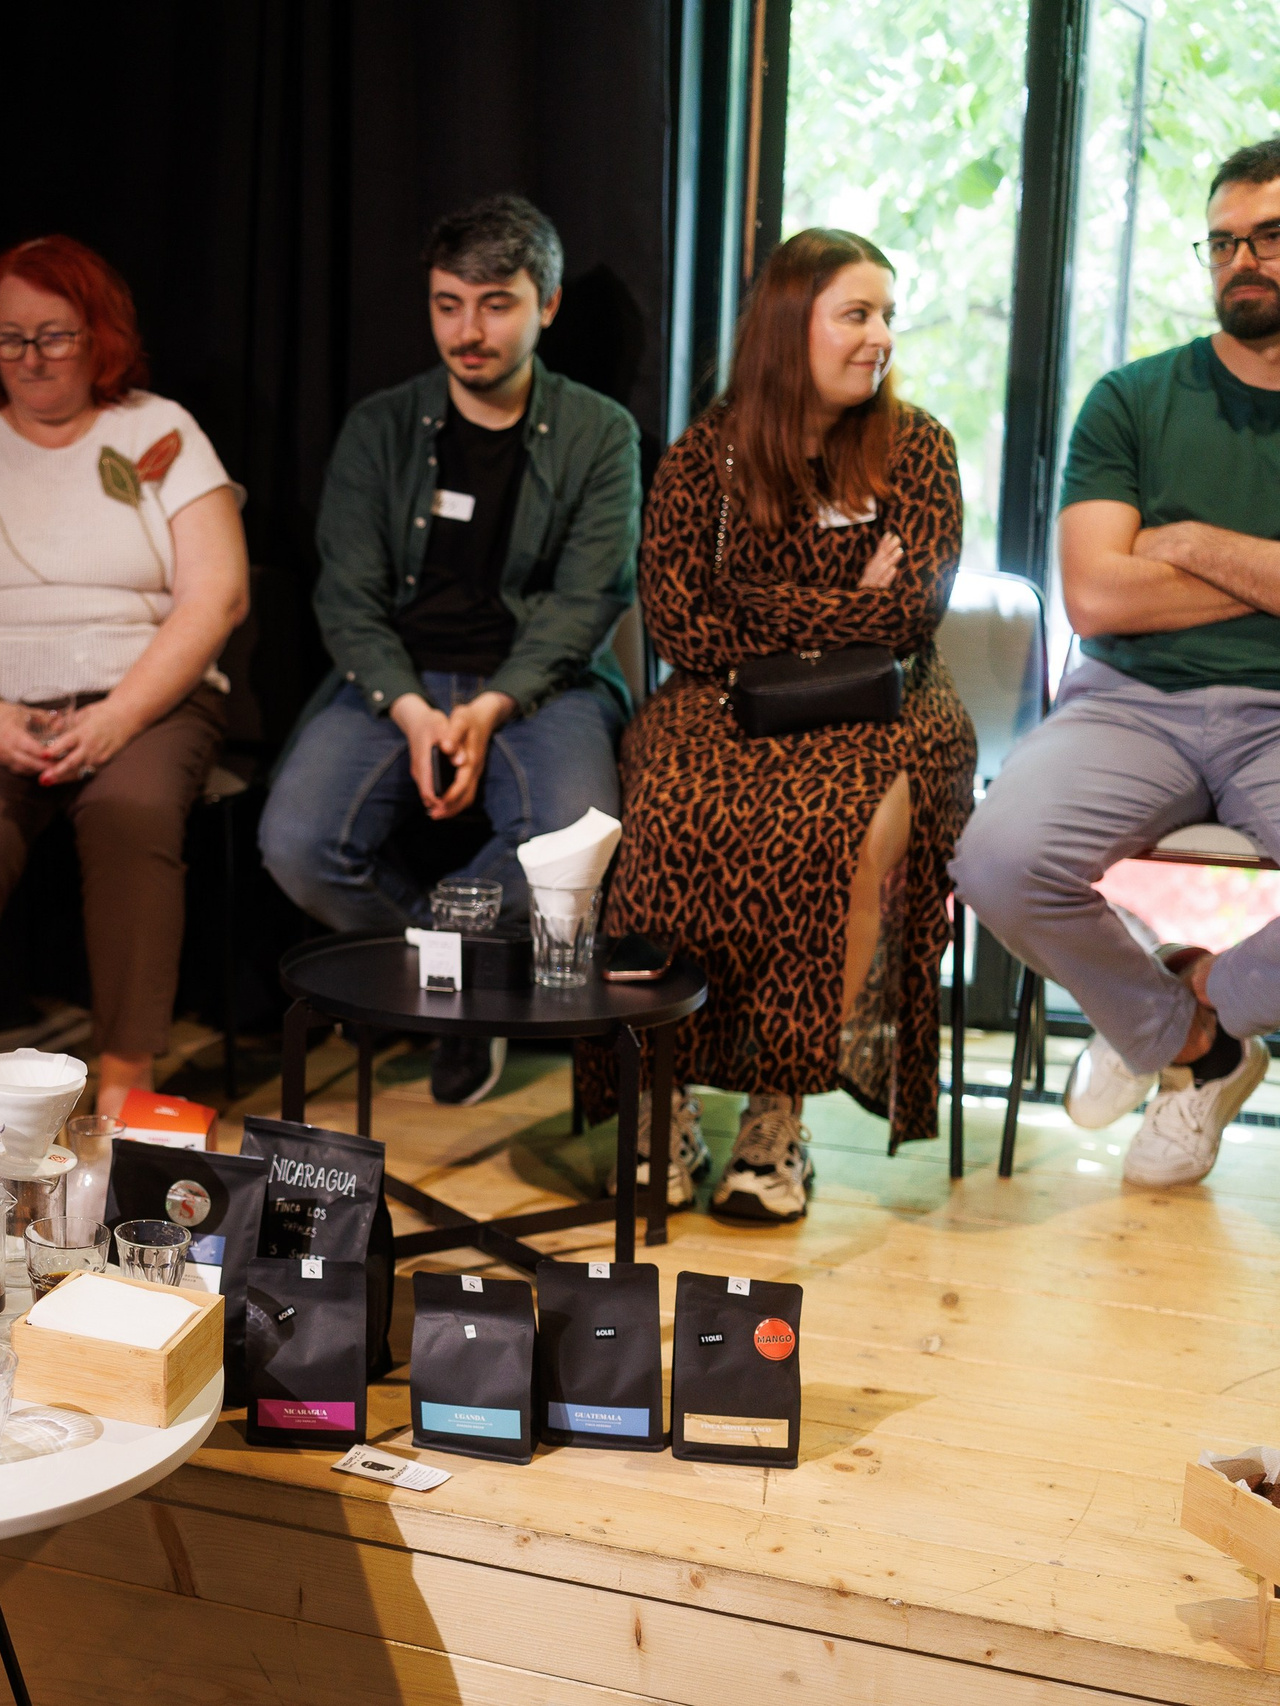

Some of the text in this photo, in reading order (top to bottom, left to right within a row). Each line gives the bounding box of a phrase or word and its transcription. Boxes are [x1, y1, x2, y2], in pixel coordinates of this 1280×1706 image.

[268, 1154, 357, 1197] NICARAGUA
[307, 1207, 327, 1220] LOS
[757, 1334, 792, 1343] MANGO
[283, 1408, 328, 1416] NICARAGUA
[454, 1412, 486, 1422] UGANDA
[574, 1411, 623, 1422] GUATEMALA
